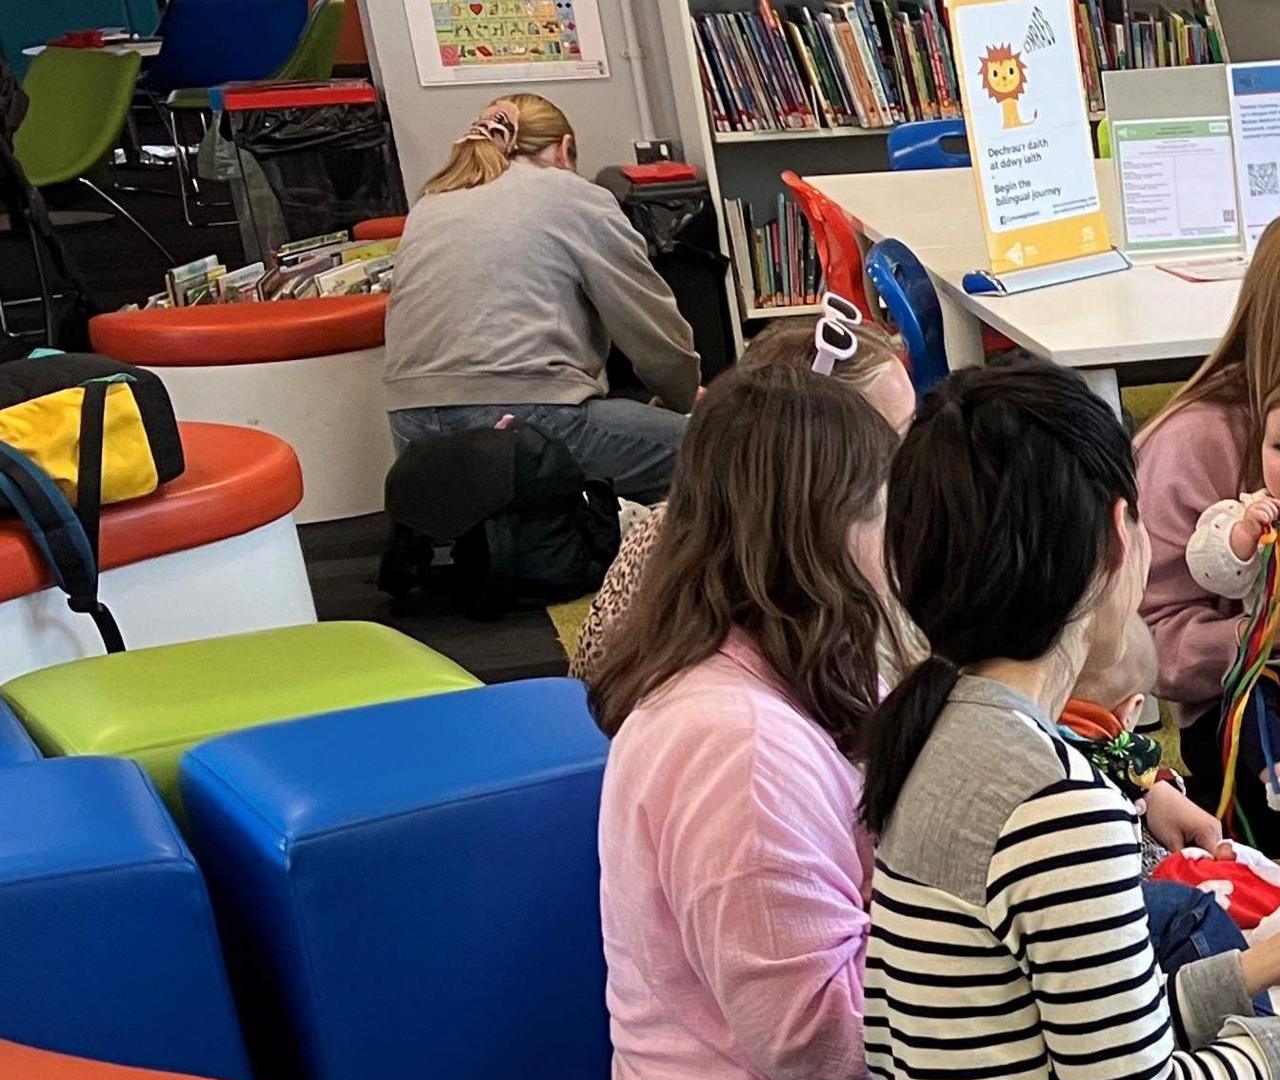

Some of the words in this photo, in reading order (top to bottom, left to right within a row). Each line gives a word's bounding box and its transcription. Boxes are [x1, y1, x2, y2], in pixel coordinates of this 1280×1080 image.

[1027, 138, 1049, 150] daith
[990, 162, 999, 171] at
[1000, 157, 1022, 168] ddwy
[1024, 152, 1042, 163] iaith
[994, 181, 1017, 194] Begin
[1018, 179, 1031, 188] the
[996, 191, 1031, 206] bilingual
[1032, 186, 1062, 201] journey
